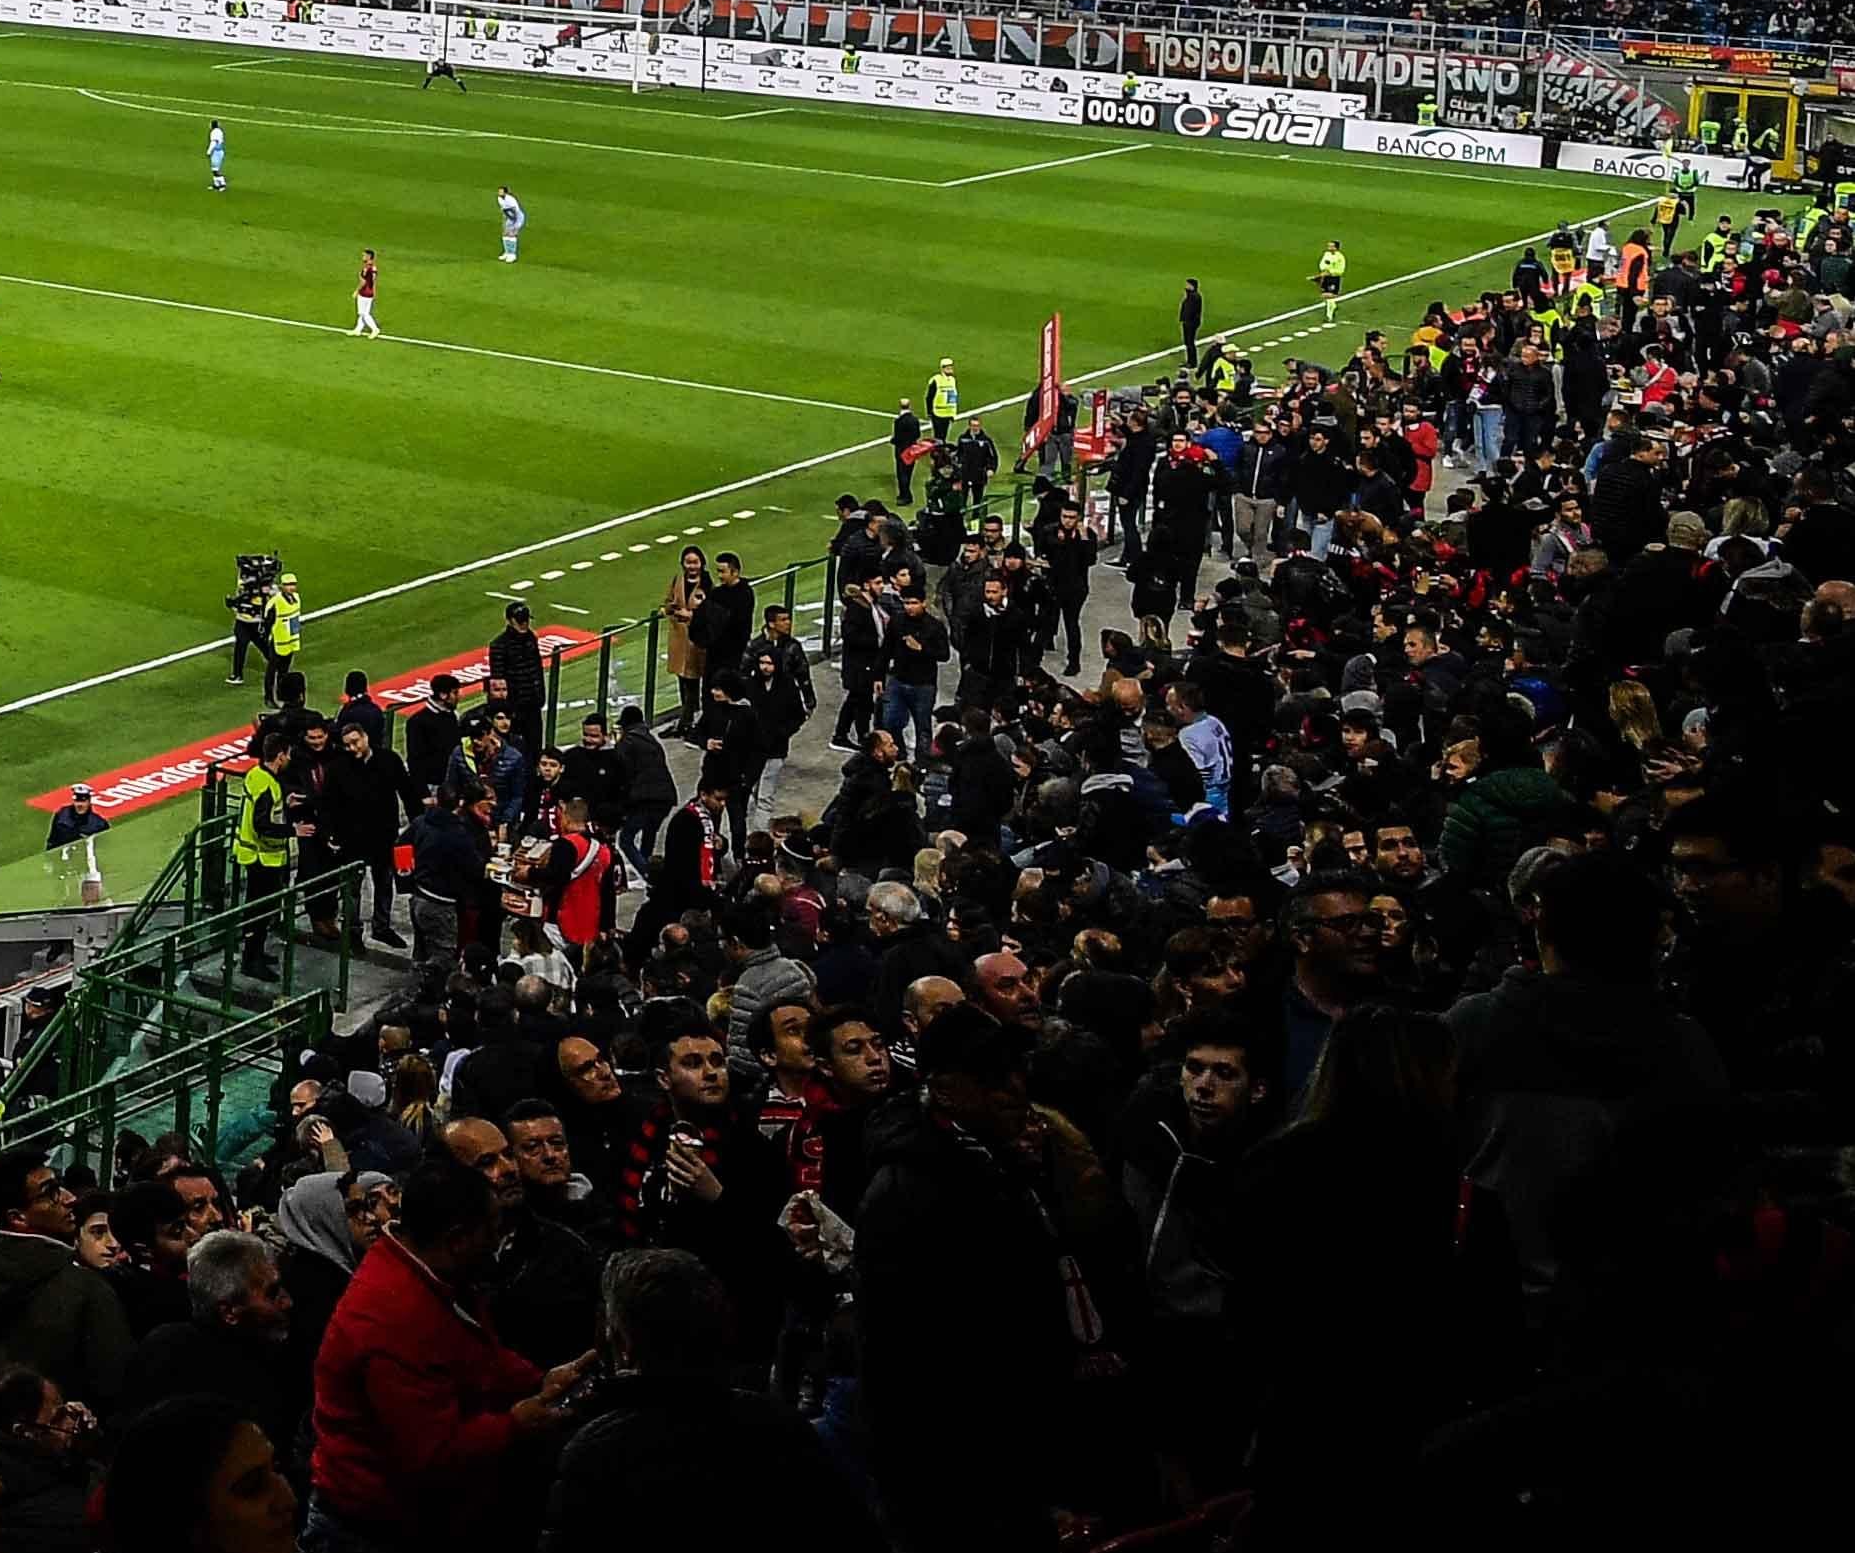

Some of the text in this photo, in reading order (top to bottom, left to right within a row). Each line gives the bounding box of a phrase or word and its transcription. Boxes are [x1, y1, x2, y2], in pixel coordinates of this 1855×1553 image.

[1143, 33, 1522, 96] TOSCOLANO MADERNO
[1087, 99, 1156, 127] 00:00
[1377, 135, 1506, 163] BANCO BPM
[1593, 157, 1665, 180] BANCO
